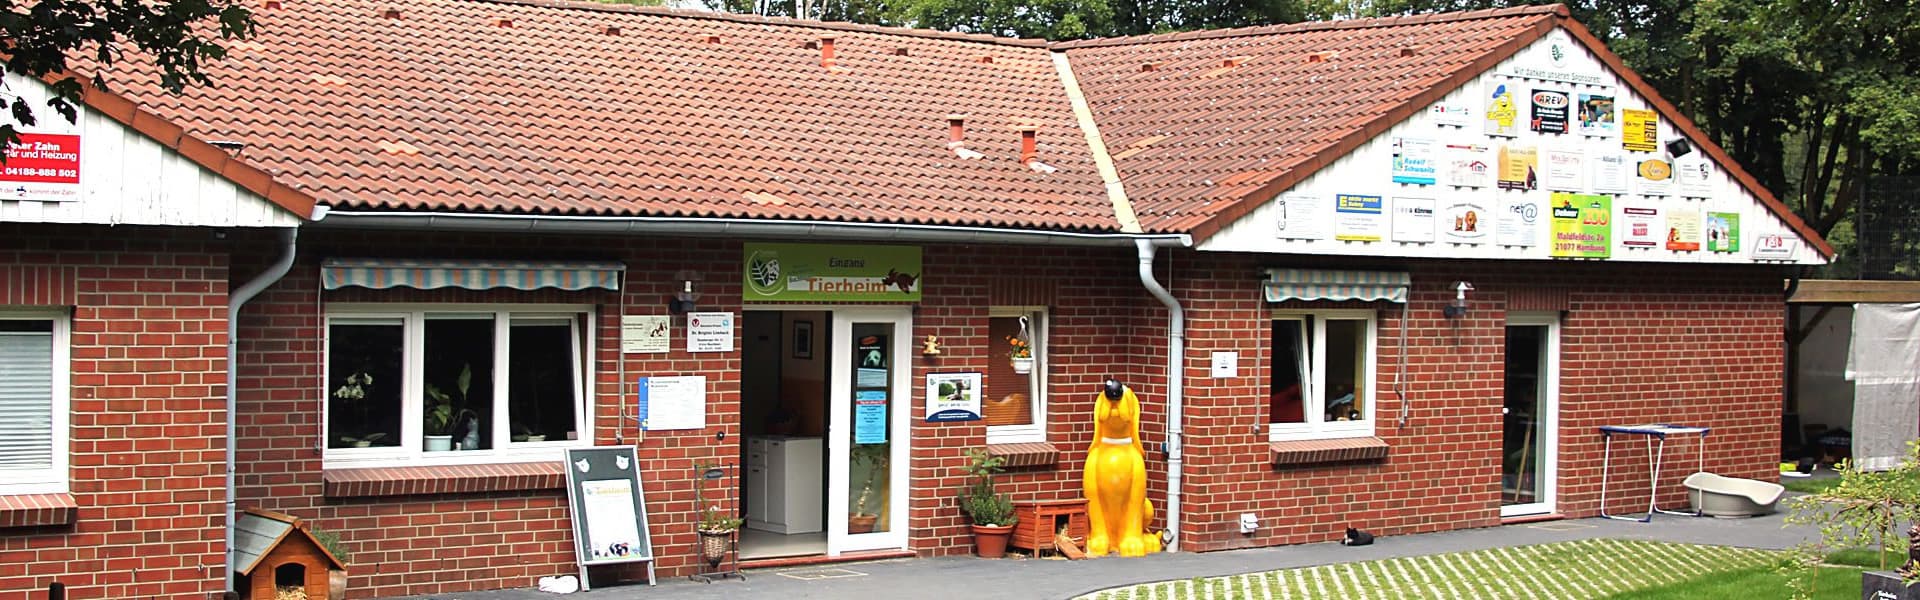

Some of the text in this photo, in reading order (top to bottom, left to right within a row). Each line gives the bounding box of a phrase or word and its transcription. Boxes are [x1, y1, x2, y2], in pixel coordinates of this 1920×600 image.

[1514, 67, 1524, 76] Wir
[1538, 94, 1563, 105] AREV
[35, 142, 60, 151] Zahn
[21, 151, 38, 159] und
[41, 152, 77, 162] Heizung
[1404, 157, 1426, 166] Rudolf
[1583, 207, 1609, 226] ZOO
[1555, 243, 1605, 254] 21077 Hamburg
[807, 278, 888, 294] Tierheim
